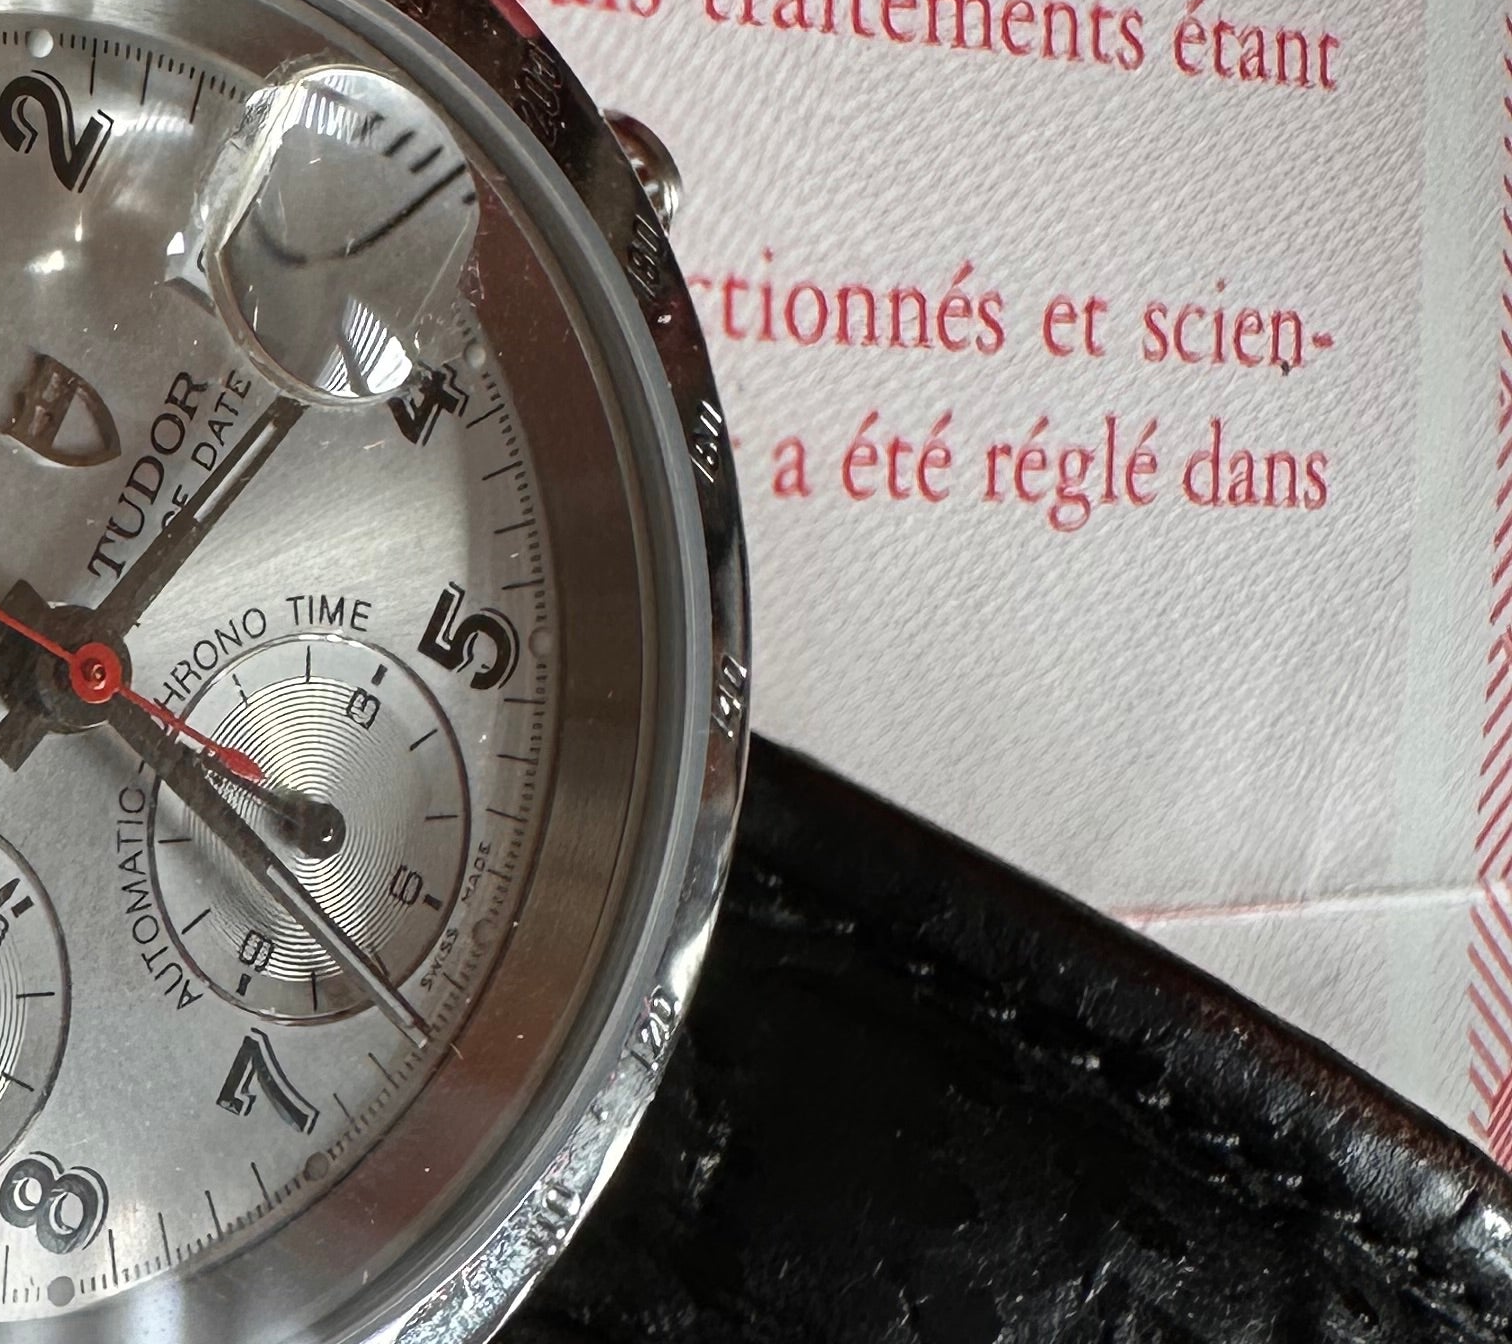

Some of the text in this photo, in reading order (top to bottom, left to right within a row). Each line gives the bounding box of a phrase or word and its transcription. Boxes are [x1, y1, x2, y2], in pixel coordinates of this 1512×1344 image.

[1043, 284, 1105, 361] et
[1142, 280, 1337, 372] scien-
[191, 368, 252, 472] DATE
[772, 412, 1328, 530] a été réglé dans
[87, 370, 209, 579] TUDOR
[286, 594, 372, 631] TIME
[417, 581, 520, 691] 5
[216, 1028, 320, 1135] 7
